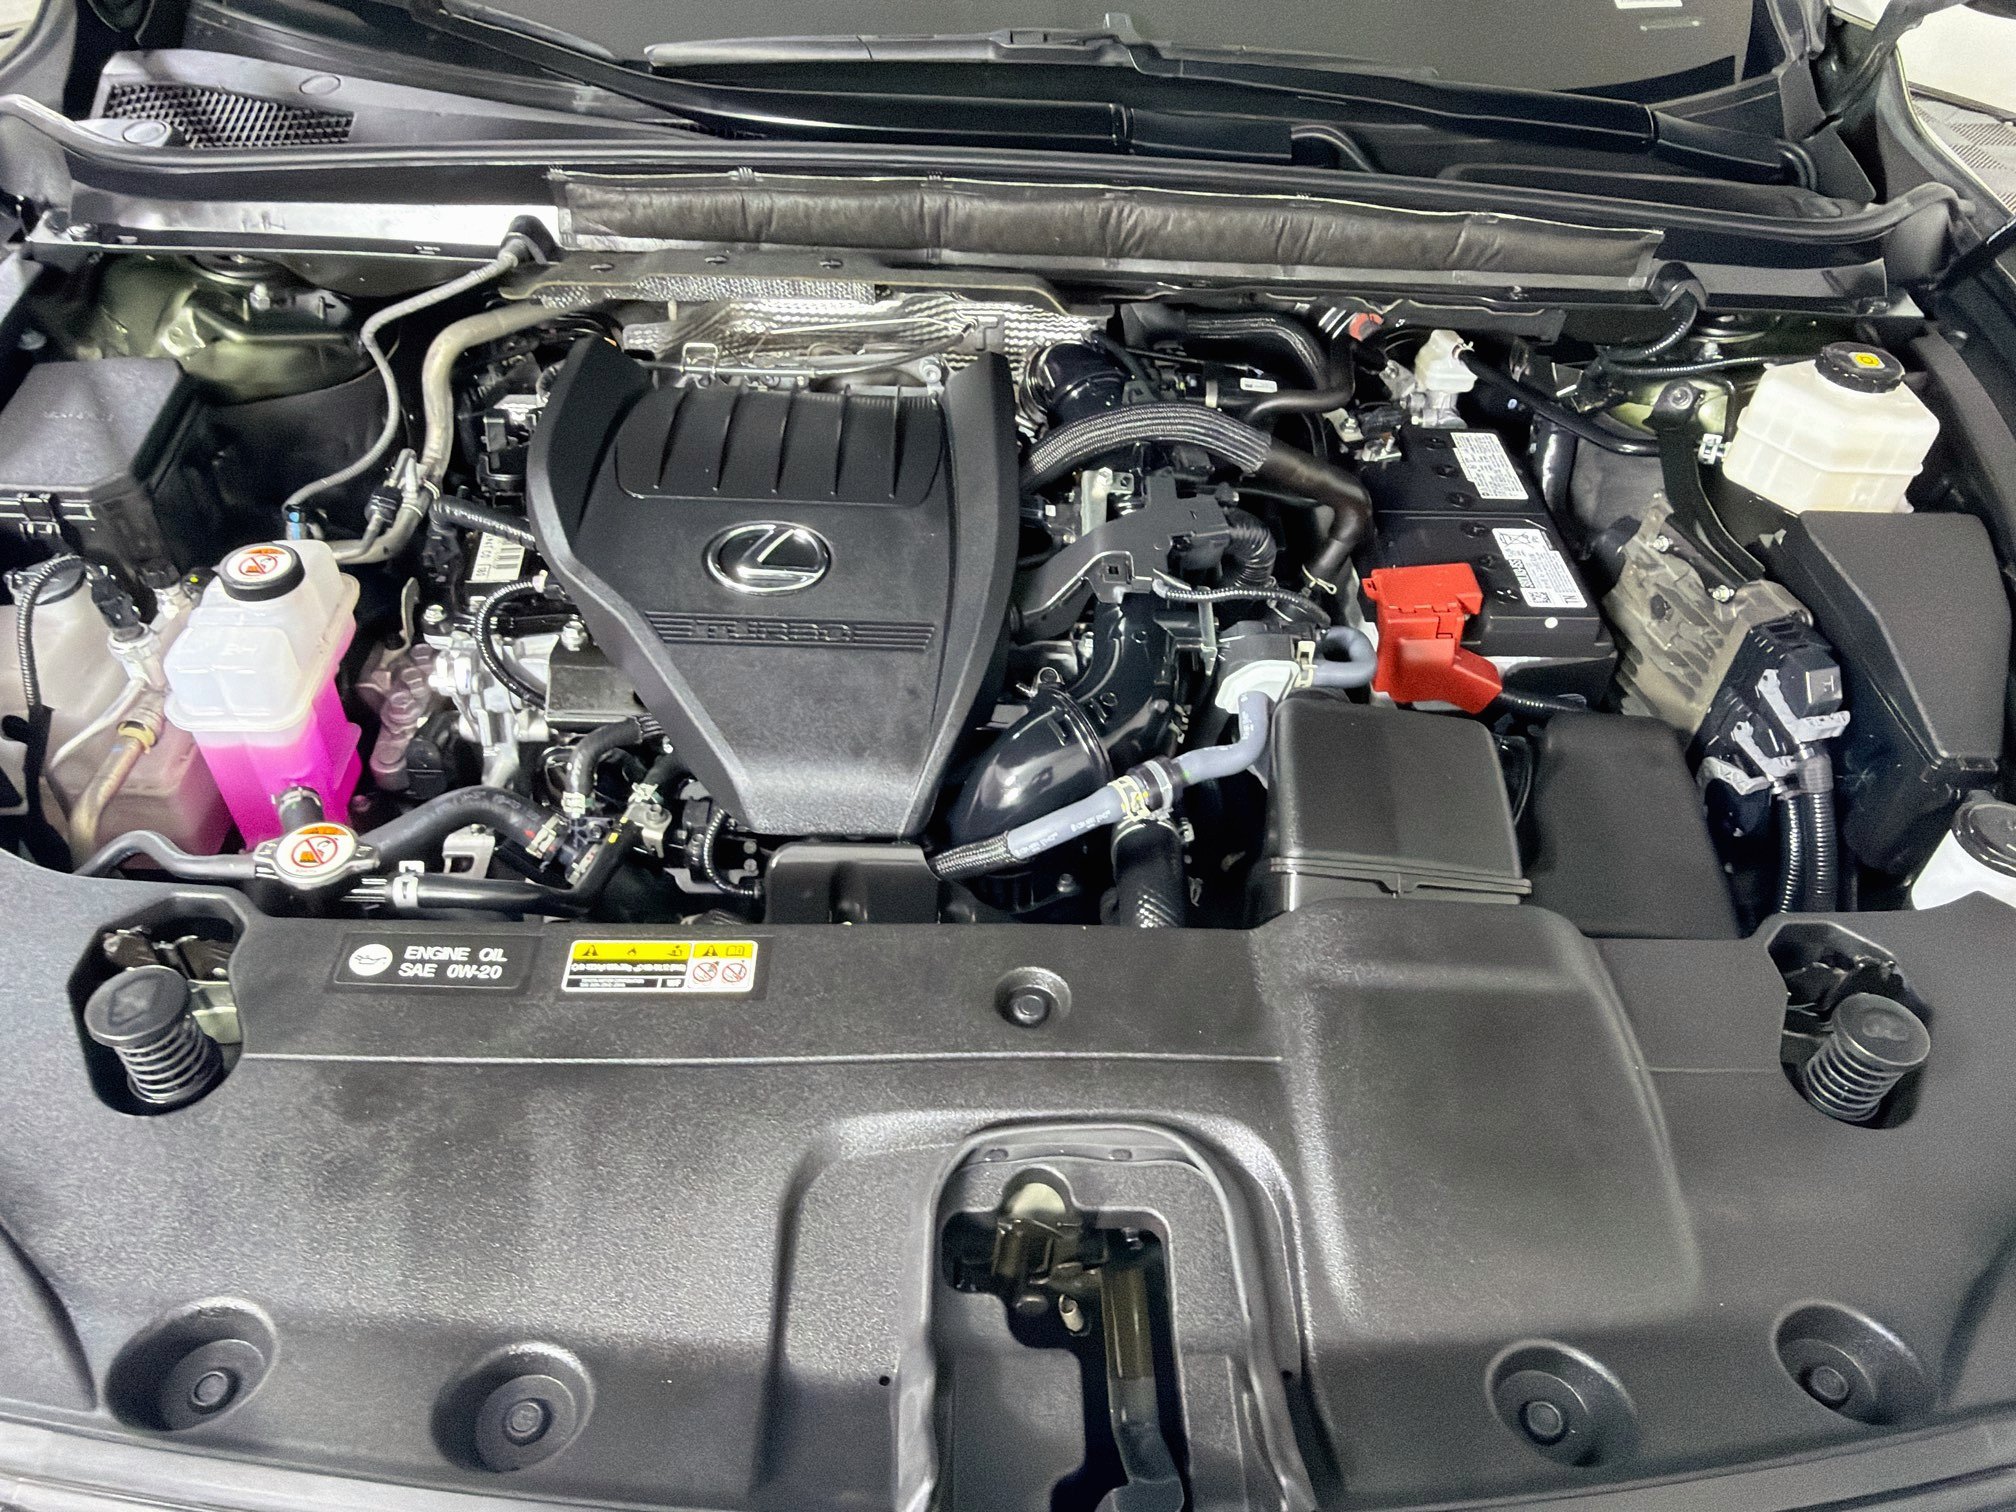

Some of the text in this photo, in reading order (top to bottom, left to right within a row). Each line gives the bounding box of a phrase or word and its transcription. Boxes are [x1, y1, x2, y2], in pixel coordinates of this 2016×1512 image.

[404, 946, 508, 962] ENGINE OIL
[398, 963, 503, 979] SAE 0W-20
